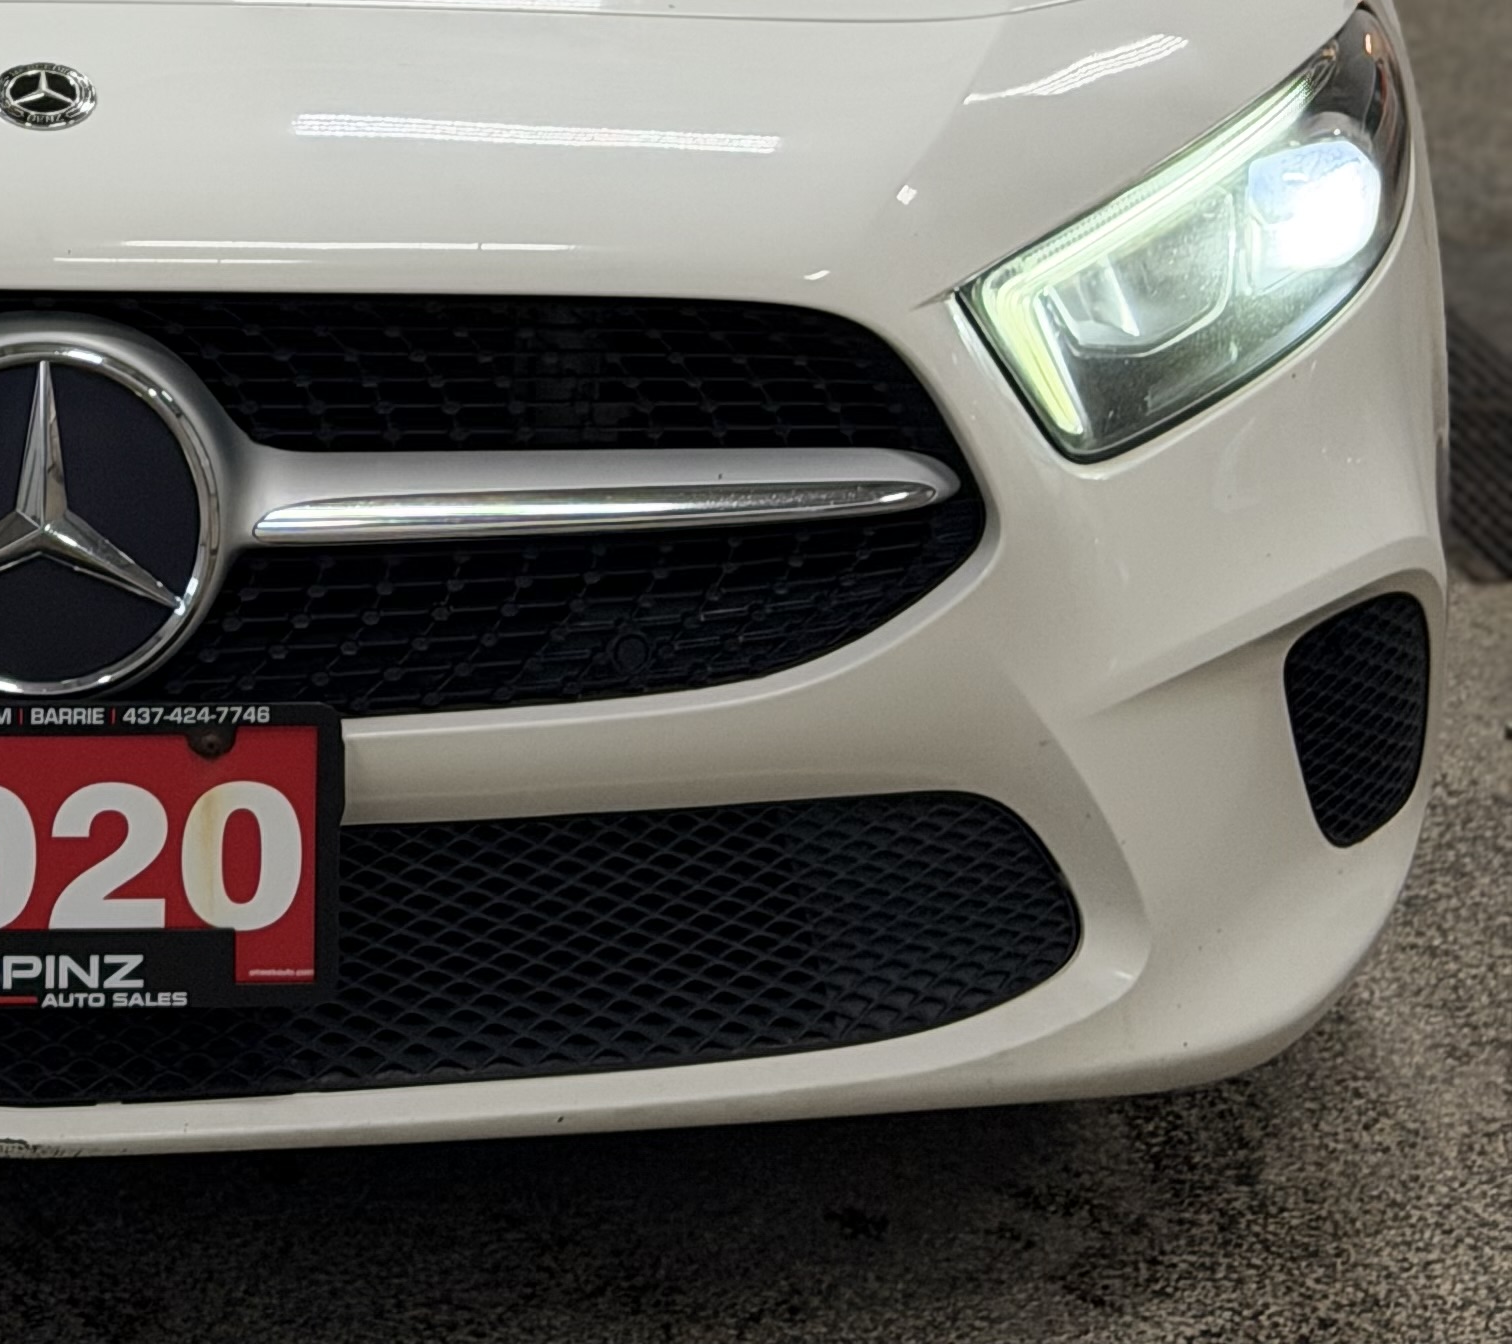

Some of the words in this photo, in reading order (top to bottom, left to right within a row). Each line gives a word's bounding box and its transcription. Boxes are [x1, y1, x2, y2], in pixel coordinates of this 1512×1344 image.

[30, 708, 105, 726] BARRIE
[122, 706, 271, 725] 437-424-7746
[41, 993, 105, 1008] AUTO
[112, 992, 188, 1007] SALES
